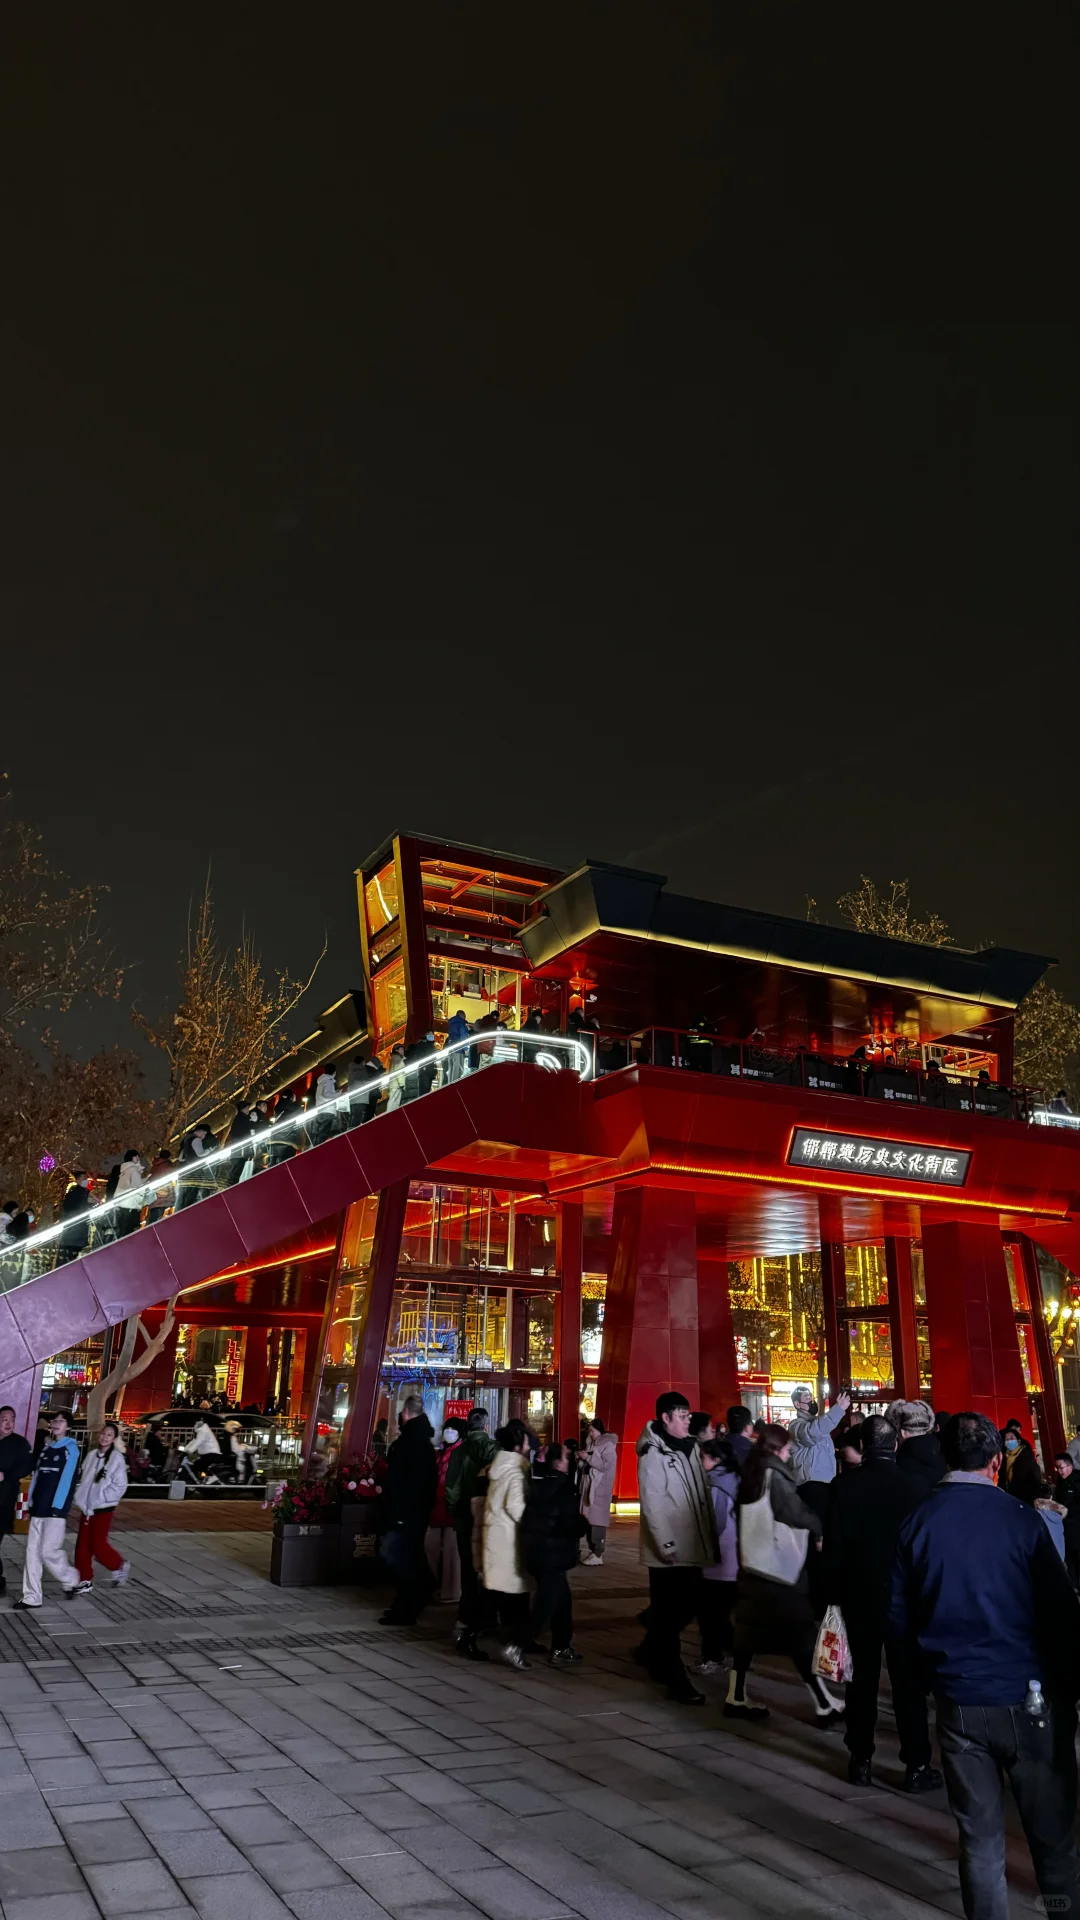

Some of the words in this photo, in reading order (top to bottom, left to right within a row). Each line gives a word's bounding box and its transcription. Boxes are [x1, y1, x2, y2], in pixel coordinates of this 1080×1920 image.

[803, 1138, 959, 1176] 邯郸道历史文化街区
